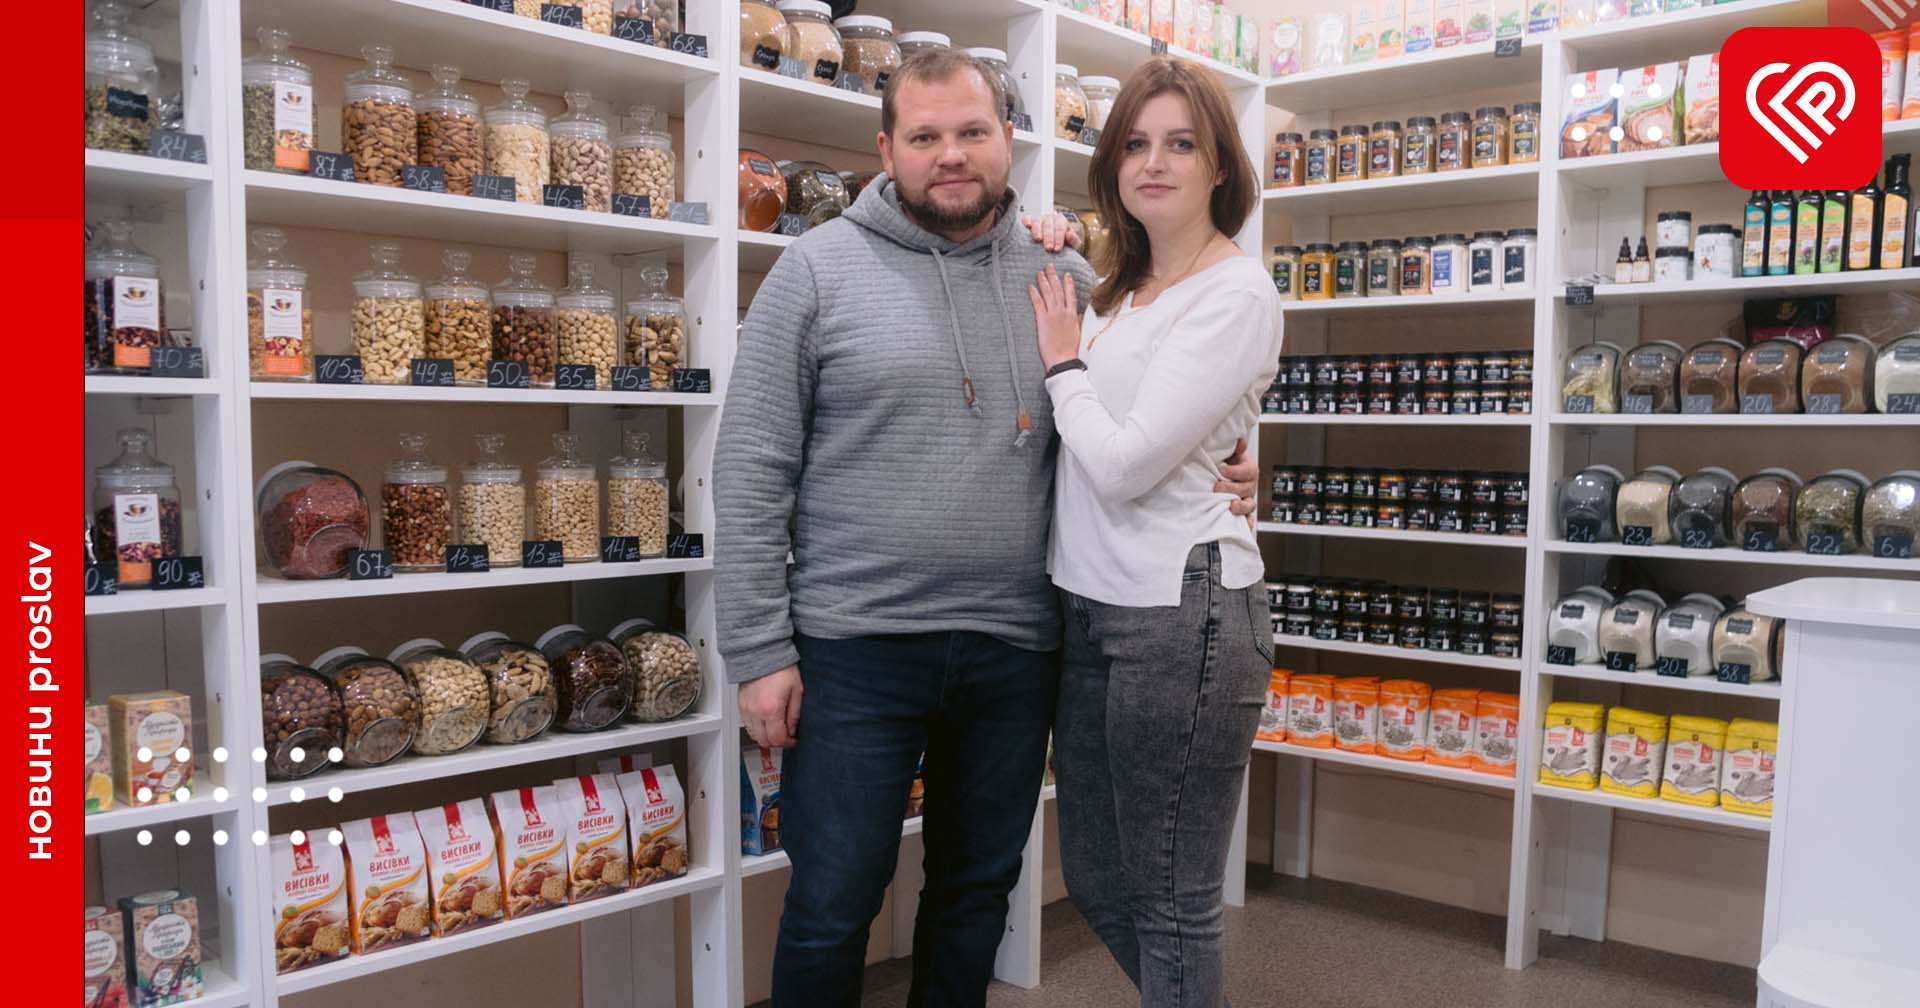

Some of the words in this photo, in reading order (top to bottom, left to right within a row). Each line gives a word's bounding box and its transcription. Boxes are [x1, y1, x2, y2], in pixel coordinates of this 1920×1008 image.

[544, 6, 574, 26] 195
[617, 19, 645, 41] 153
[672, 35, 696, 52] 68
[157, 135, 188, 160] 84
[315, 154, 337, 178] 87
[405, 167, 430, 190] 38
[475, 178, 500, 200] 44
[545, 187, 571, 208] 46
[614, 195, 638, 216] 57
[154, 349, 182, 369] 70
[319, 358, 351, 380] 105
[415, 361, 439, 383] 49
[490, 361, 522, 386] 50
[558, 366, 587, 388] 35
[613, 367, 640, 389] 45
[676, 370, 697, 390] 75
[1810, 394, 1831, 413] 28
[669, 535, 690, 554] 14
[1625, 527, 1646, 543] 23
[1747, 531, 1764, 550] 5
[1809, 534, 1836, 553] 22
[526, 543, 546, 564] 13
[604, 537, 627, 560] 14
[1880, 536, 1895, 557] 6
[356, 552, 385, 577] 67
[449, 548, 471, 568] 13
[157, 559, 184, 585] 90
[1612, 652, 1623, 669] 6
[1658, 658, 1680, 675] 20
[1721, 663, 1740, 682] 38
[577, 815, 615, 831] ВИСІВКИ
[641, 804, 675, 822] ВИСІВКИ
[516, 829, 555, 844] ВИСІВКИ
[440, 841, 482, 861] ВИСІВКИ
[369, 856, 411, 873] ВИСІВКИ
[284, 872, 331, 893] ВИСІВКИ
